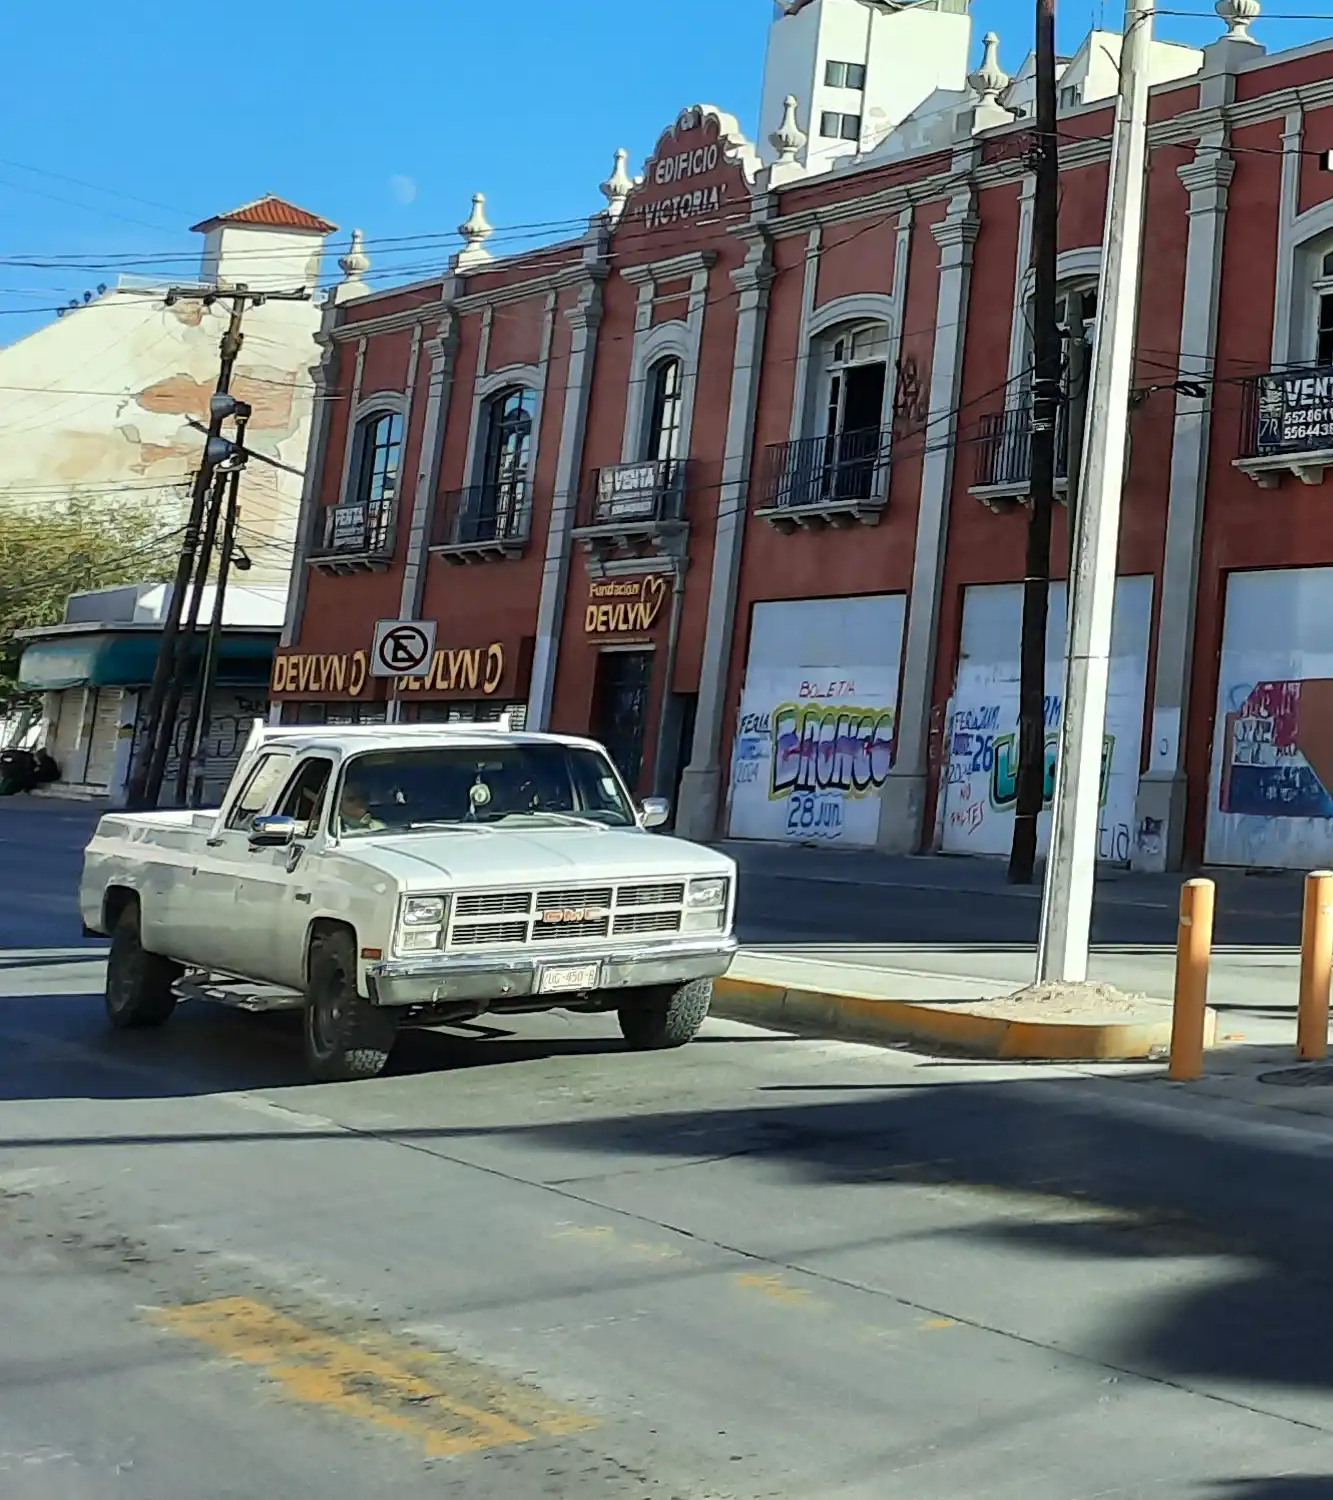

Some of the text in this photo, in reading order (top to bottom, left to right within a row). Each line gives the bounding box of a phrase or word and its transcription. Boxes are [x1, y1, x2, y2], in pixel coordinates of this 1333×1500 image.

[655, 144, 718, 184] EDIFICIO
[584, 602, 652, 632] DEVLYN
[273, 654, 347, 692] DEVLYN
[398, 649, 480, 691] VLYN
[772, 708, 893, 793] BRONCO
[972, 735, 994, 772] 26
[788, 796, 814, 828] 28
